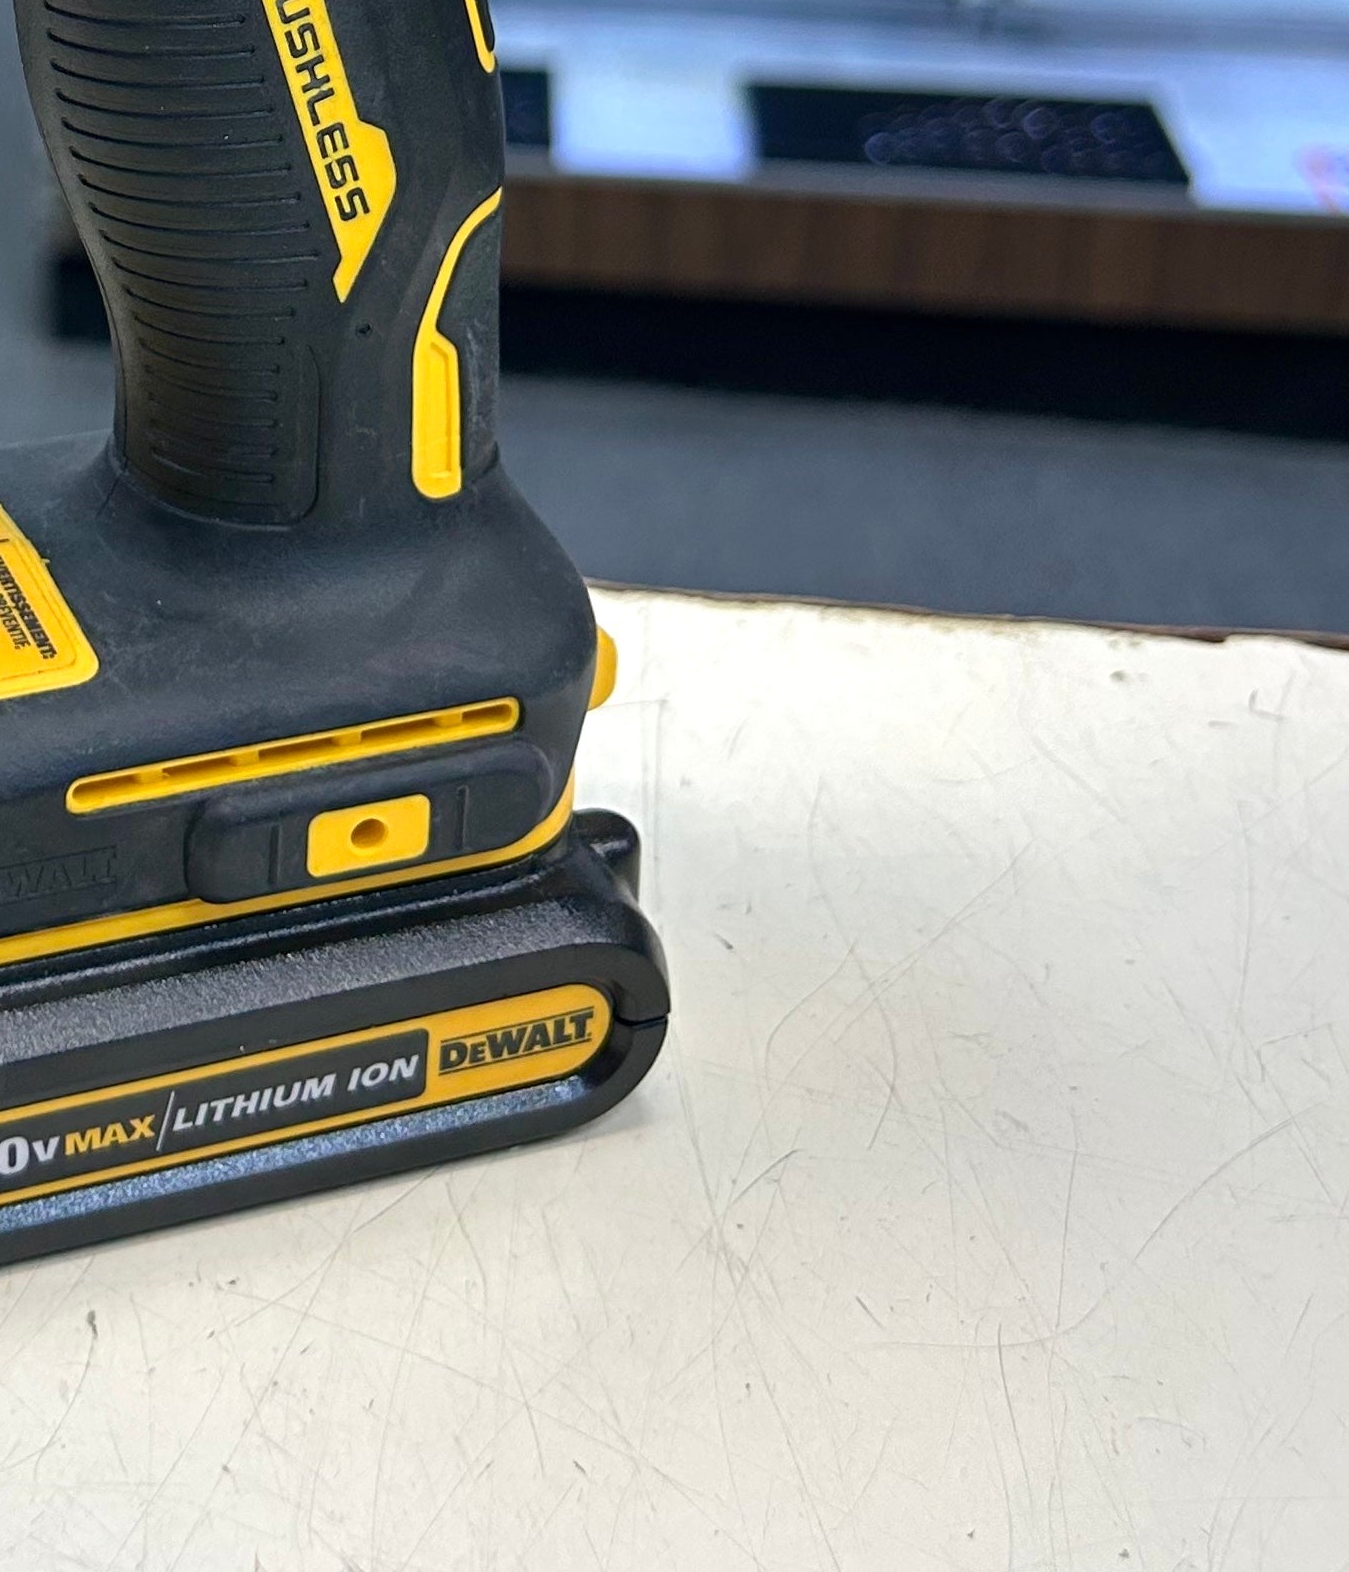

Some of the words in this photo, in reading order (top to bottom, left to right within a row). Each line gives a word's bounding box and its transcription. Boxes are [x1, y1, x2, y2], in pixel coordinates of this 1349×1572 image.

[64, 1113, 155, 1157] MAX
[171, 1072, 337, 1132] LITHIUM
[346, 1054, 421, 1092] ION
